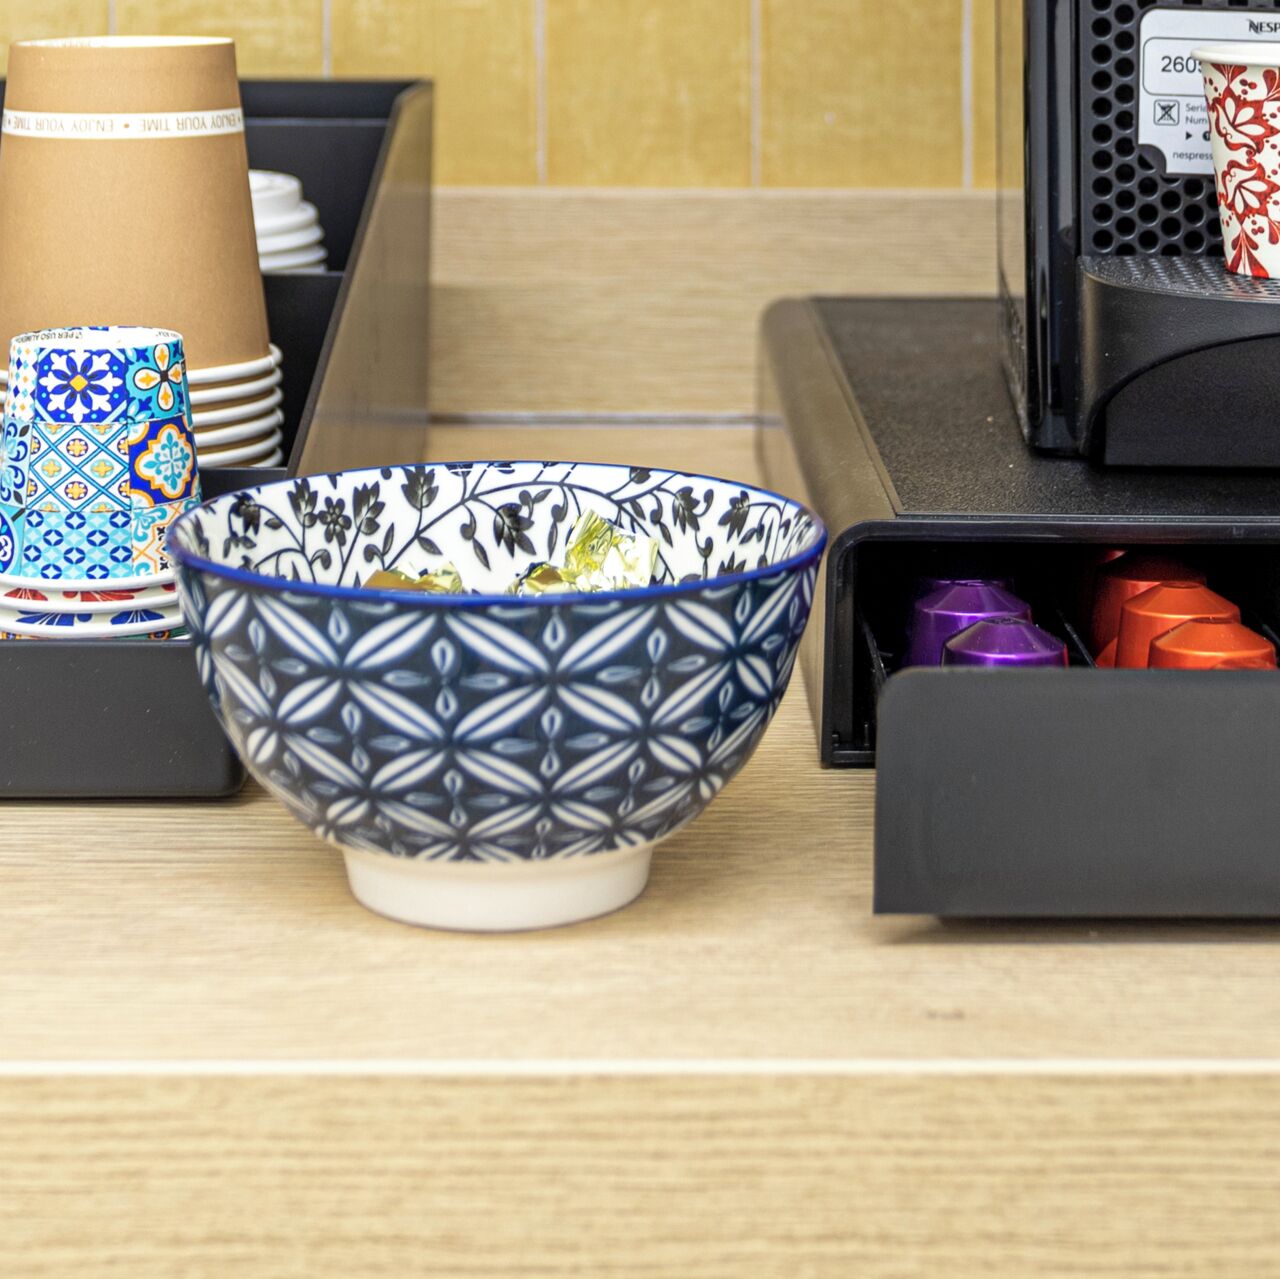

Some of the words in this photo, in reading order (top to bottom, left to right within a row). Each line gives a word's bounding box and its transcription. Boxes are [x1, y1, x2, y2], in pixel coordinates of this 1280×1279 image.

[35, 118, 65, 132] YOUR
[71, 119, 114, 133] ENJOY
[141, 119, 170, 132] TIME
[176, 116, 207, 131] YOUR
